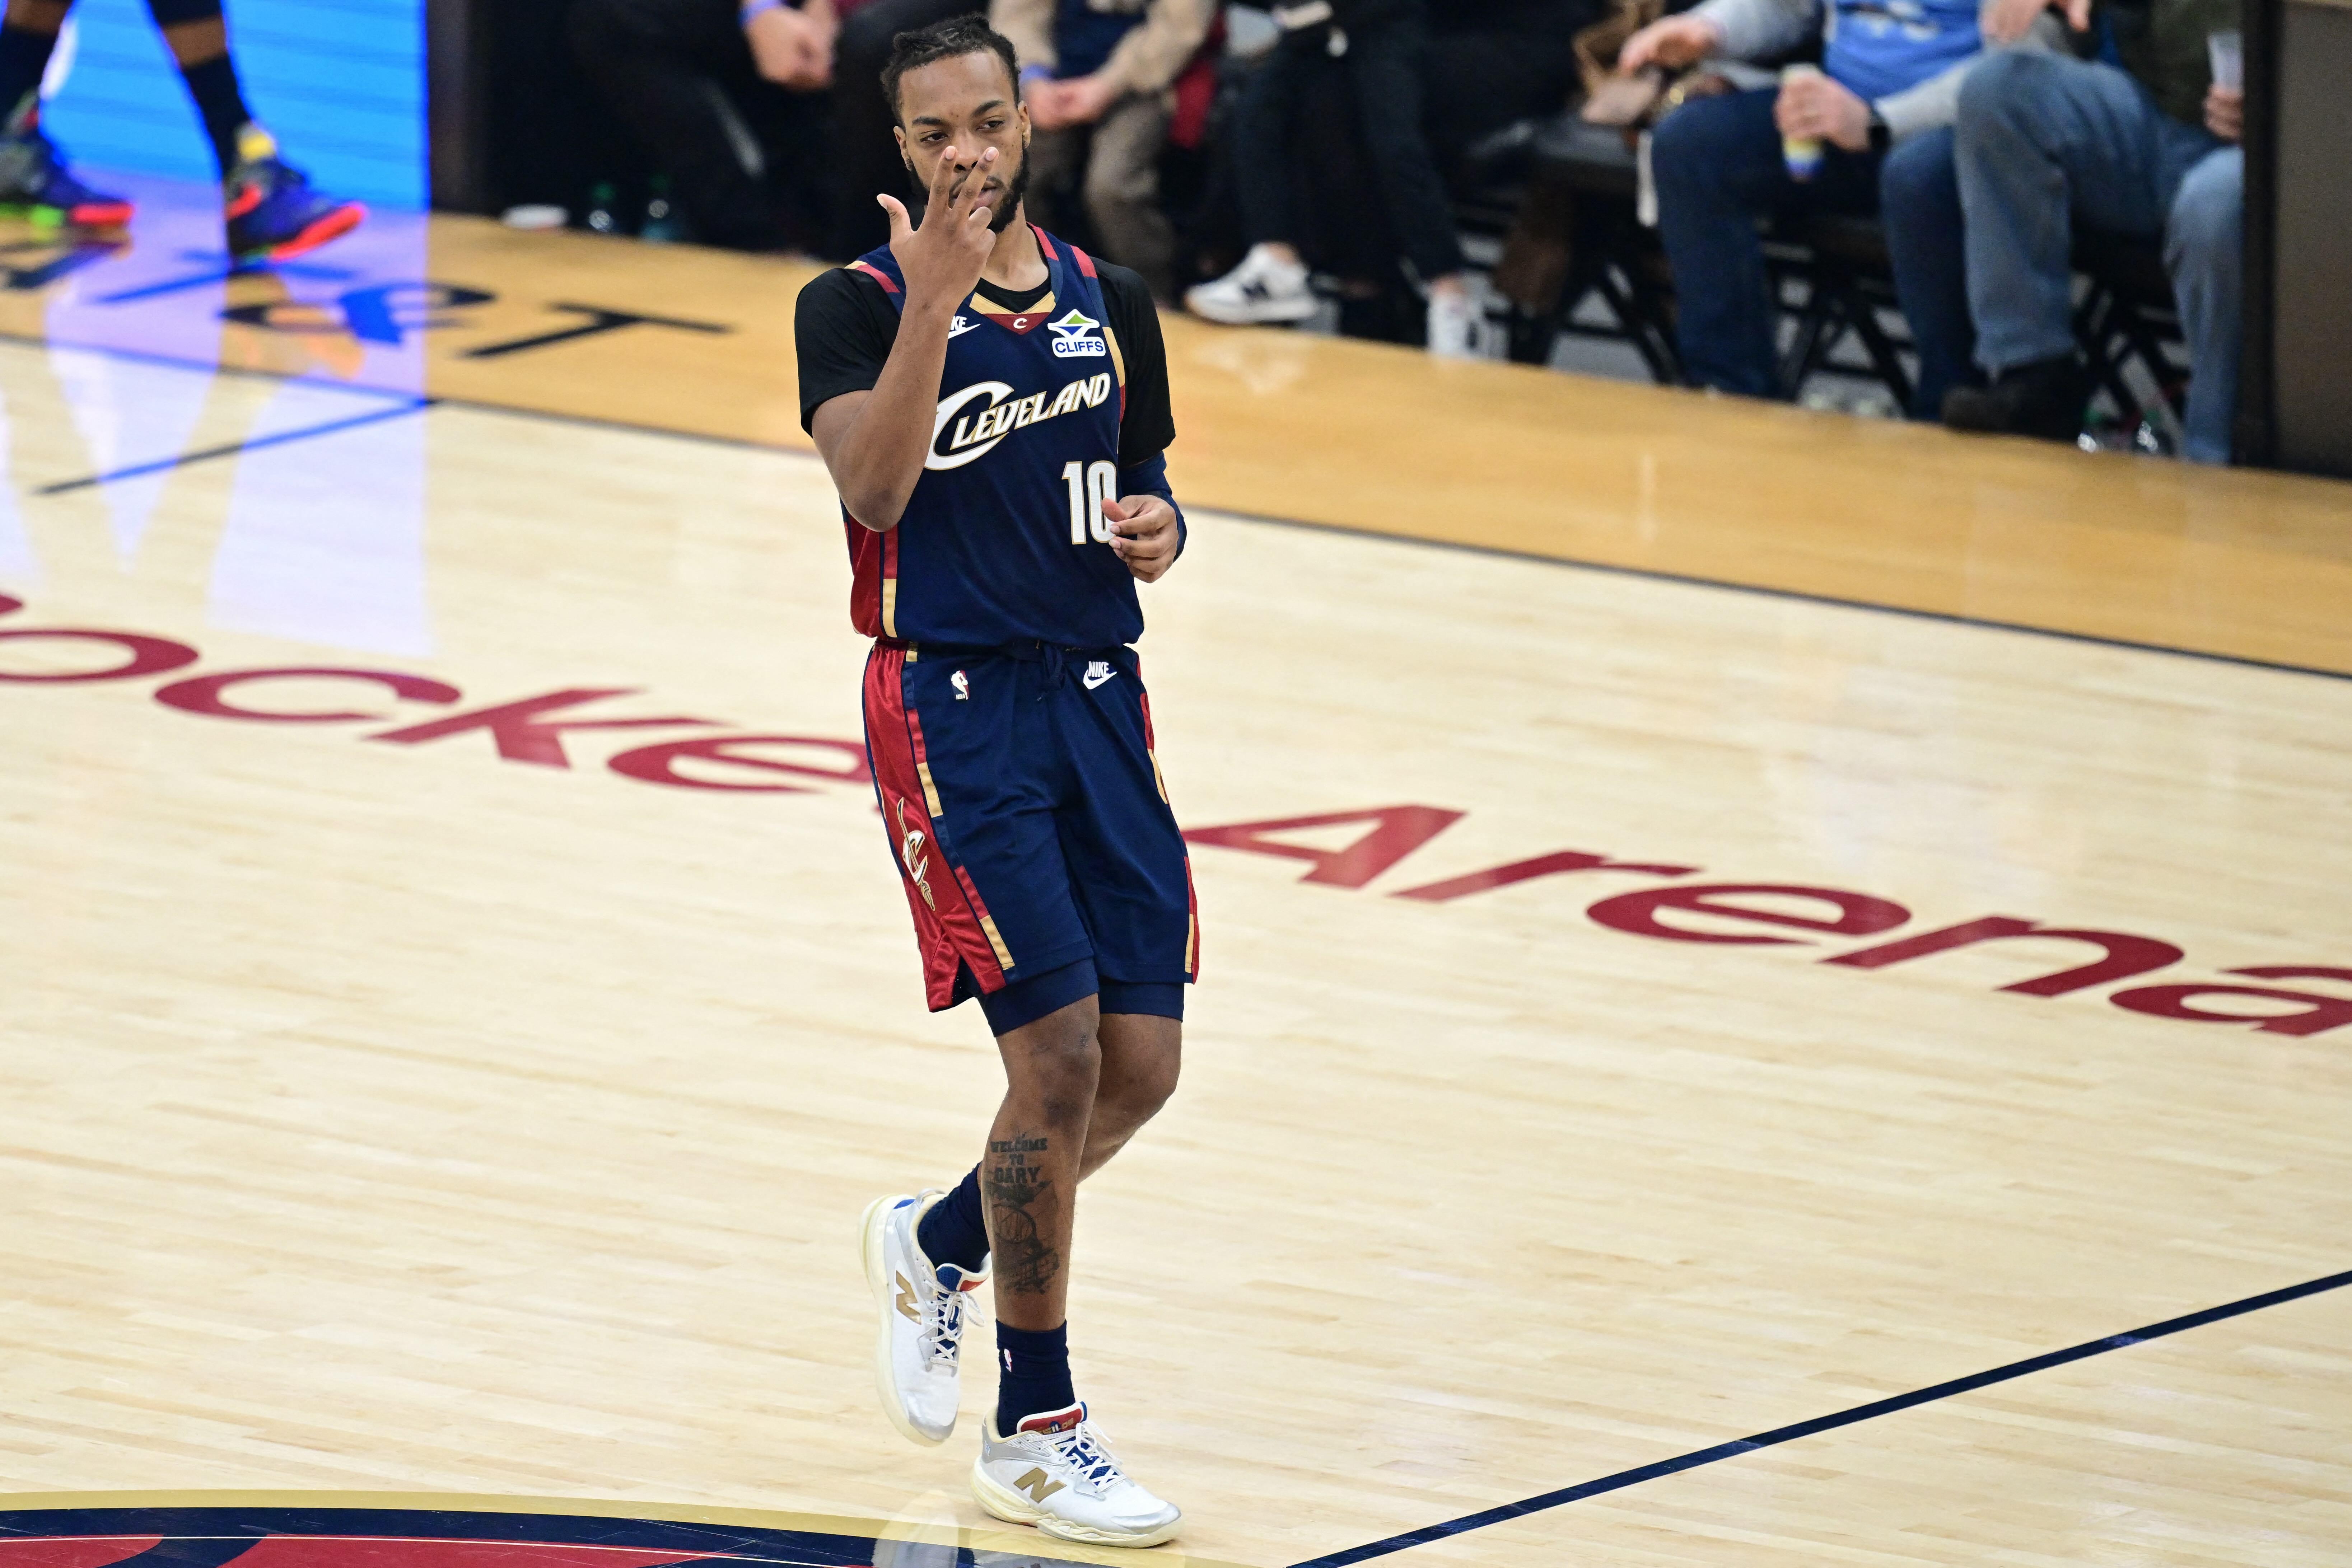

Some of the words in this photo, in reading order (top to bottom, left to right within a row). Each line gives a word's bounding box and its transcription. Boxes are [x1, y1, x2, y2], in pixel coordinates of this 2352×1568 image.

[950, 315, 967, 331] KE
[1013, 318, 1027, 329] C
[1055, 341, 1103, 353] CLIFFS
[924, 372, 1111, 471] CLEVELAND
[1061, 460, 1117, 545] 10
[1088, 661, 1109, 677] NIKE
[0, 593, 882, 815] ocke
[1180, 804, 2352, 1036] Arena
[896, 1269, 922, 1325] N
[1013, 1467, 1067, 1504] N
